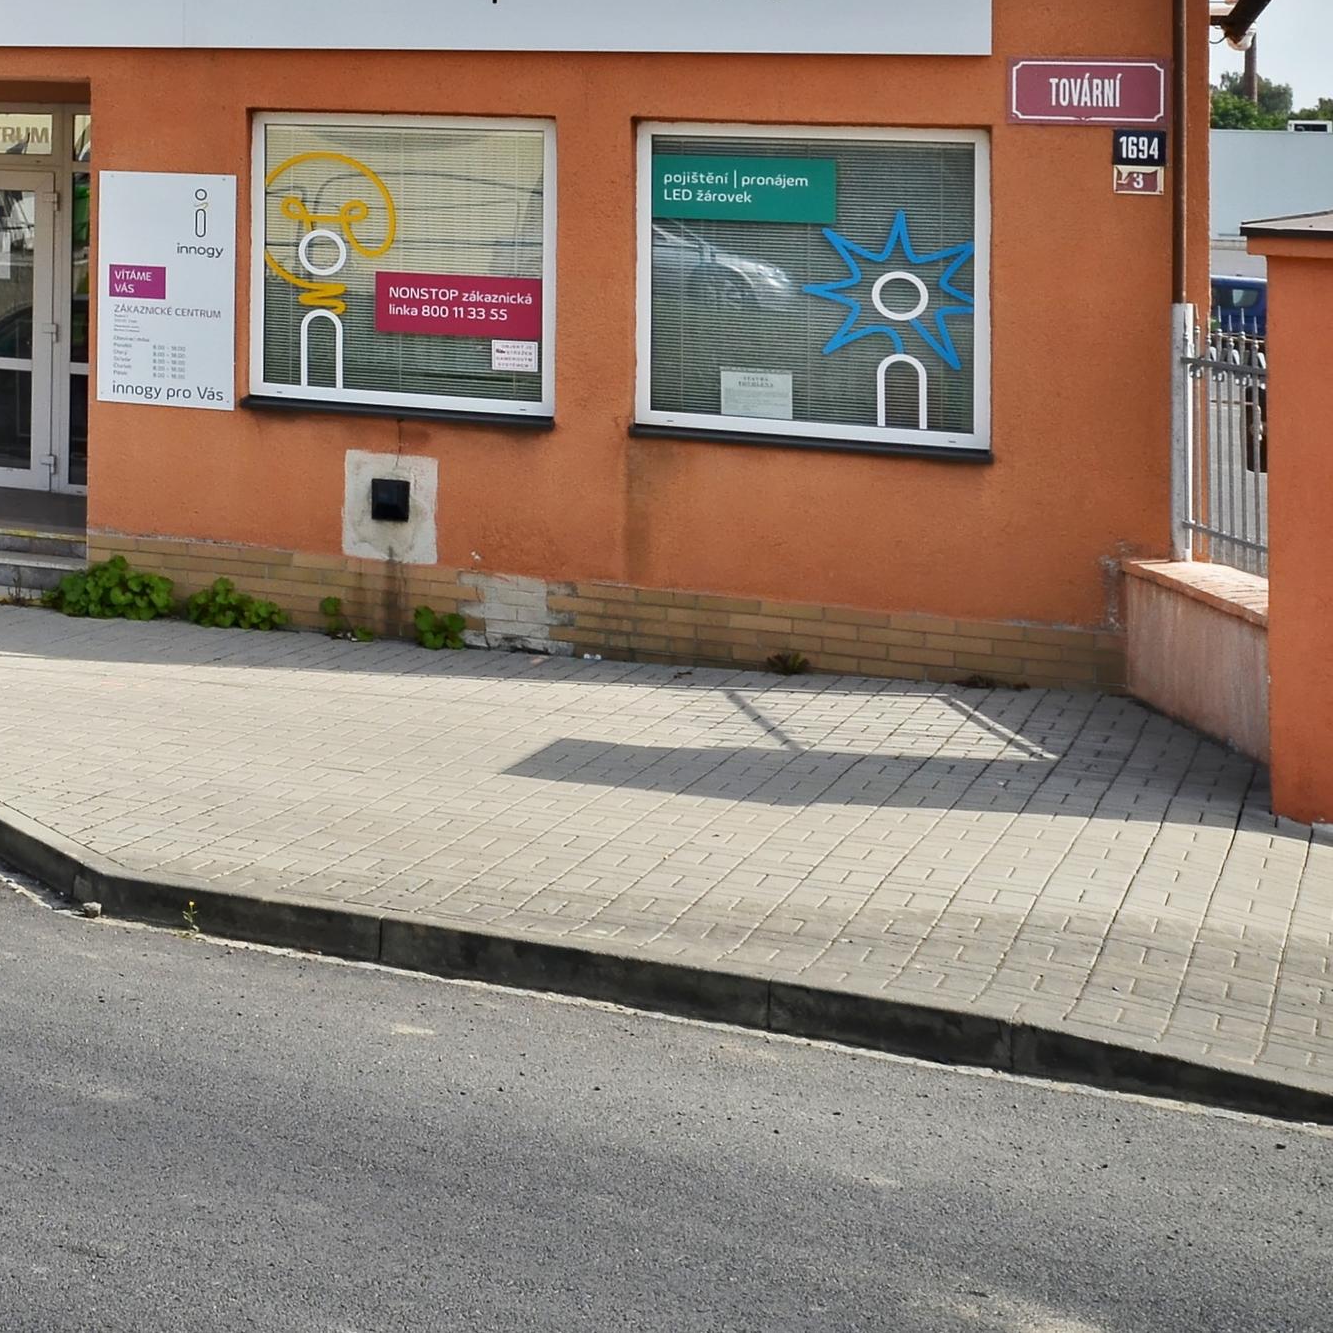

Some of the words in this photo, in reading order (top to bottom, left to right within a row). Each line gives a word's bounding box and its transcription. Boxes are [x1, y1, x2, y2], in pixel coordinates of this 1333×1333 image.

[1049, 72, 1123, 108] TOVÁRNÍ
[1119, 136, 1159, 160] 1694
[663, 171, 729, 186] pojištění
[741, 173, 809, 188] pronájem
[1132, 172, 1144, 188] 3
[663, 188, 693, 201] LED
[696, 190, 753, 203] žárovek
[176, 242, 224, 258] innogy
[114, 269, 152, 282] VÍTÁME
[114, 282, 135, 294] VÁS
[388, 286, 459, 301] NONSTOP
[462, 291, 533, 305] zákaznická
[113, 303, 172, 316] ZÁKAZNICKÉ
[174, 308, 221, 319] CENTRUM
[388, 305, 418, 316] linka
[421, 305, 449, 318] 800
[452, 307, 464, 319] 11
[467, 307, 486, 320] 33
[489, 309, 508, 321] 55
[112, 380, 162, 400] innogy
[166, 387, 192, 400] pro
[197, 386, 224, 402] Vás
